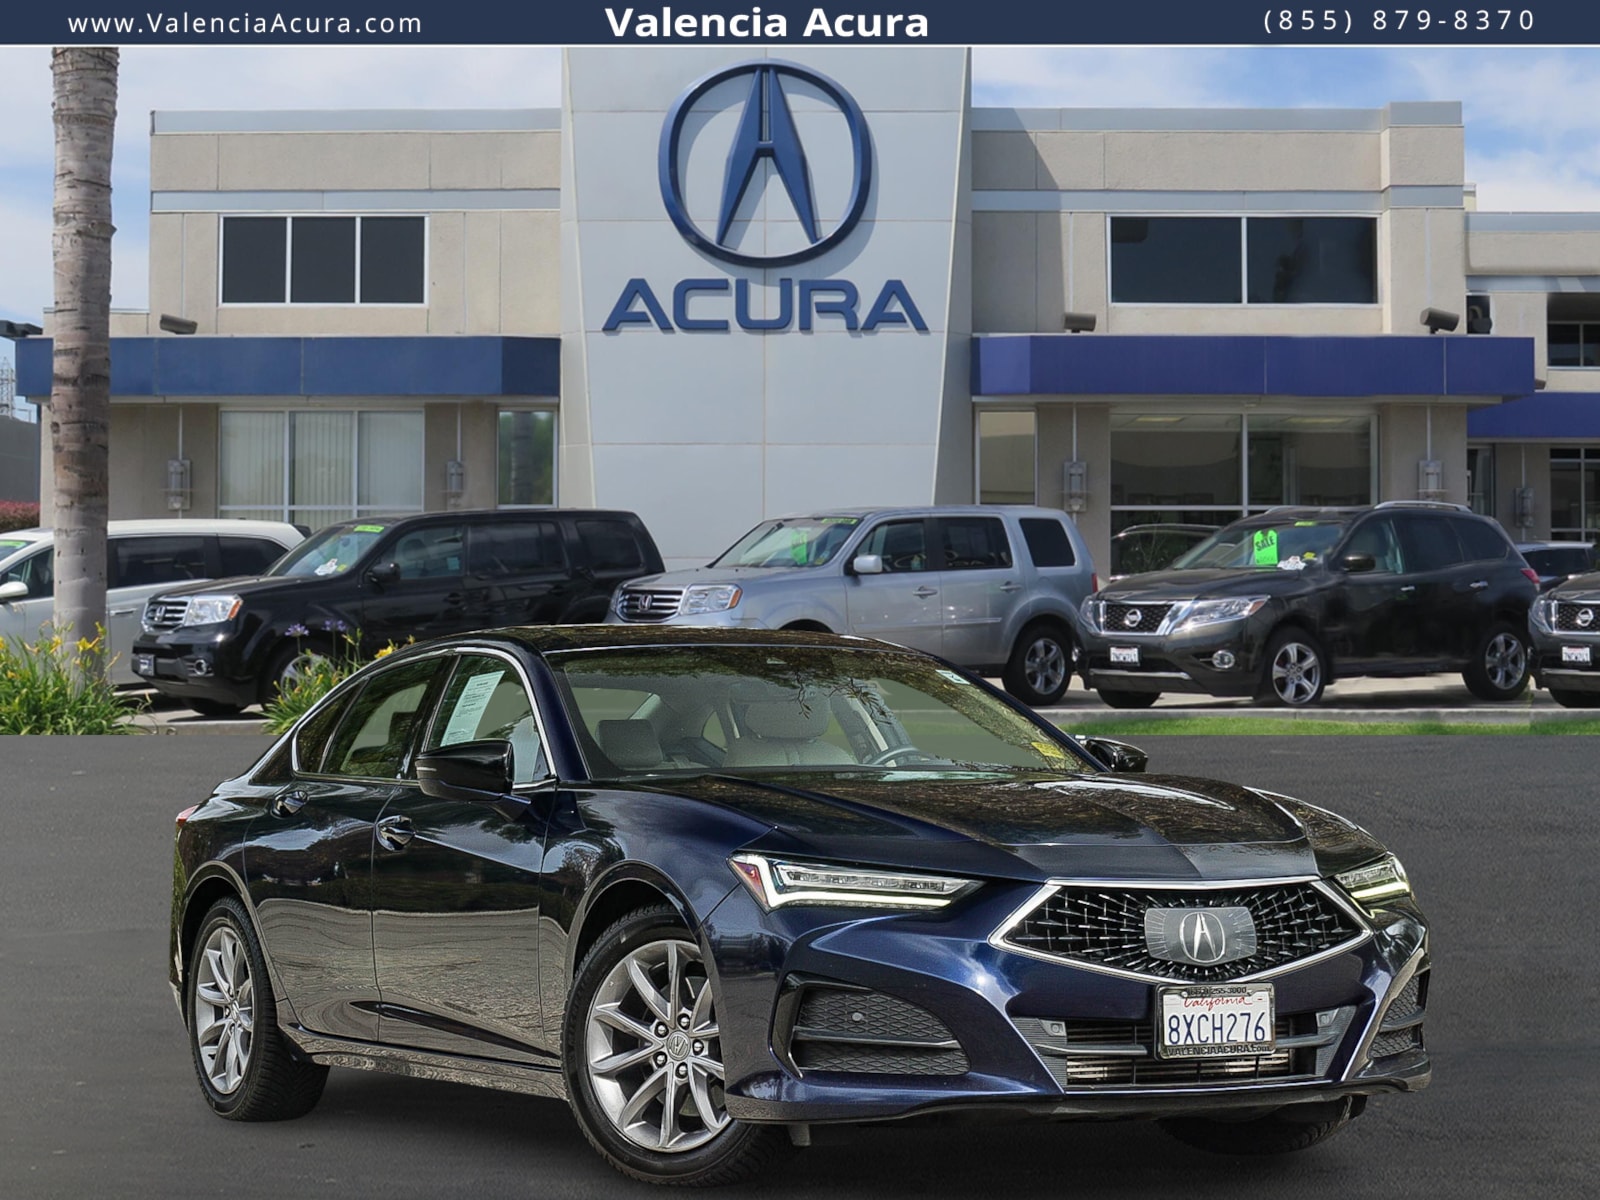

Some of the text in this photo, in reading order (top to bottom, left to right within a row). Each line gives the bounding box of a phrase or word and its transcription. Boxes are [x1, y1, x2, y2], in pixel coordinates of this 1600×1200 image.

[602, 278, 929, 332] ACURA
[1184, 996, 1253, 1011] California
[1168, 1012, 1266, 1045] 8XCH276
